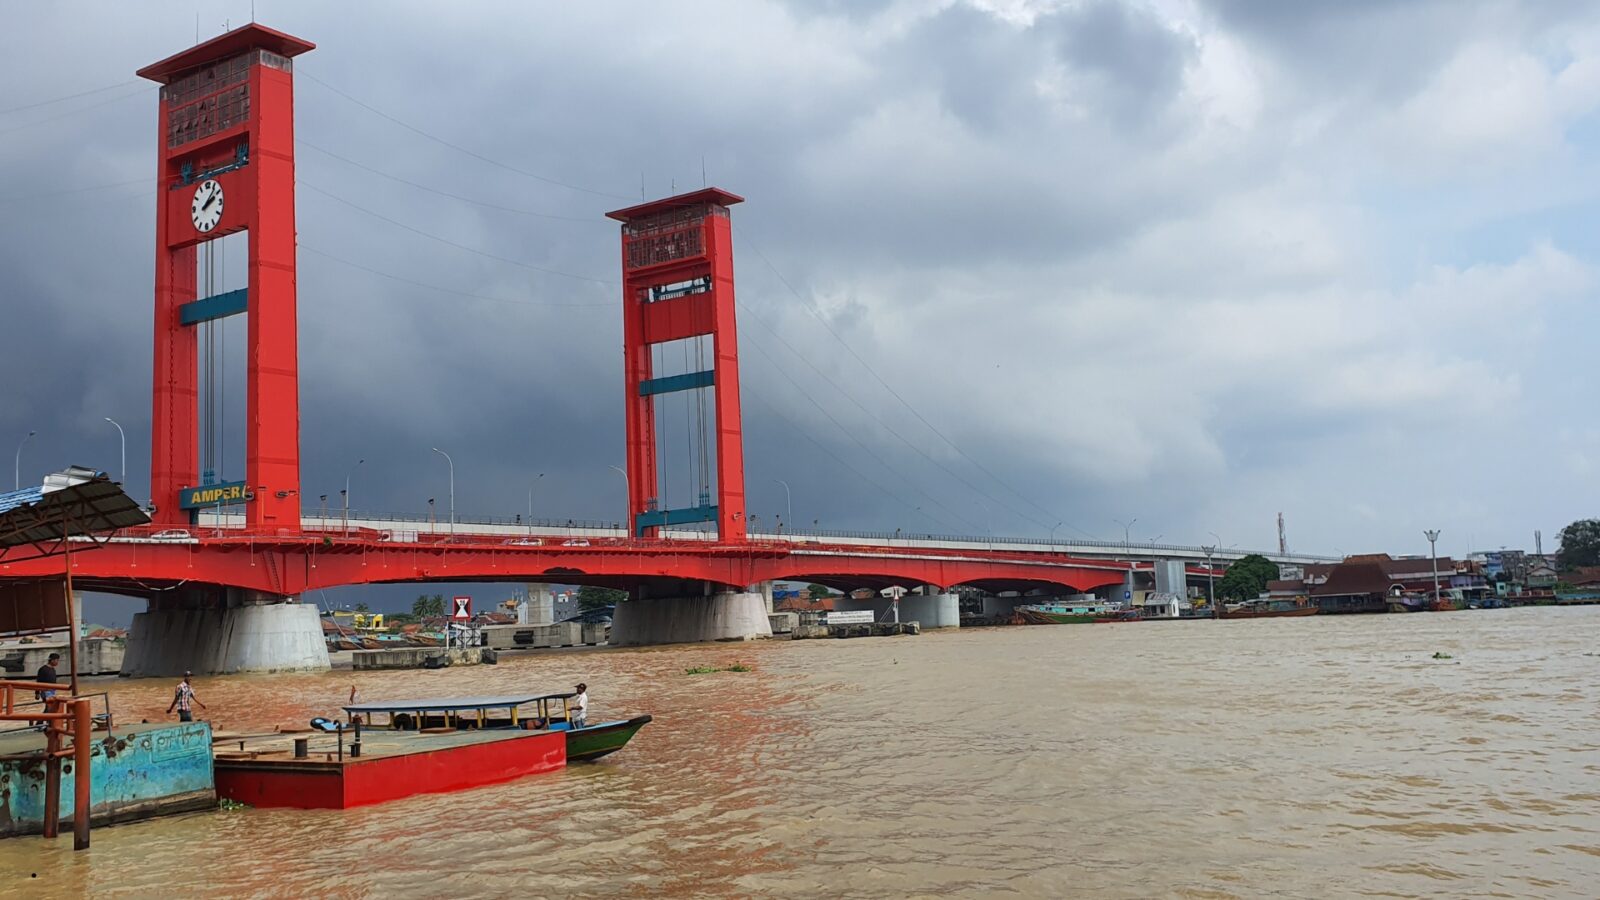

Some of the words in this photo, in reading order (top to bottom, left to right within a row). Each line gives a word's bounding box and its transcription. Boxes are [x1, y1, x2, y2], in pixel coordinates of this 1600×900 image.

[205, 181, 211, 189] 12
[218, 198, 223, 206] 3
[192, 205, 197, 213] 9
[204, 222, 209, 230] 6
